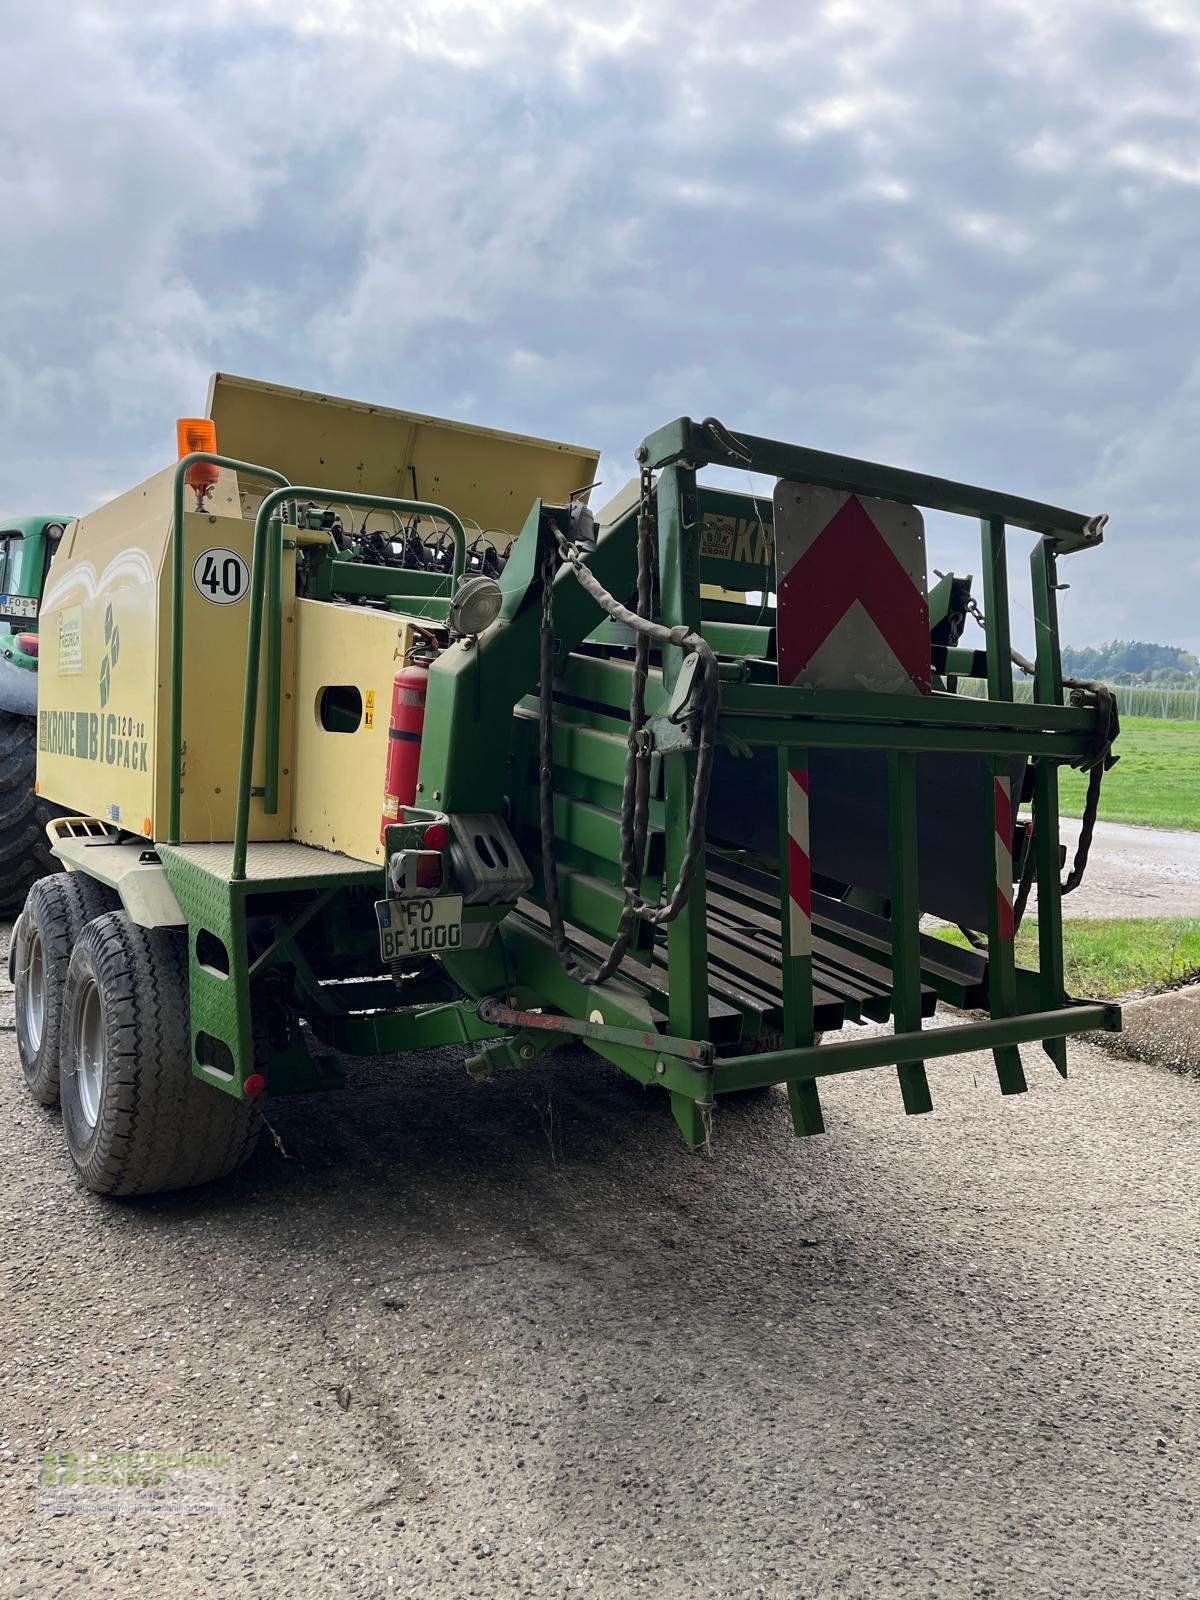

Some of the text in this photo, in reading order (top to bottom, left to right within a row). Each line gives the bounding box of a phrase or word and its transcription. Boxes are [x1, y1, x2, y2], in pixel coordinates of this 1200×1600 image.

[702, 547, 729, 557] KRONE
[202, 557, 241, 596] 40
[4, 605, 17, 615] FL
[9, 597, 21, 607] FO
[47, 710, 75, 757] KRONE
[89, 712, 117, 765] BIG
[116, 738, 148, 772] PACK
[407, 900, 434, 925] FO
[384, 924, 461, 957] BF 1000
